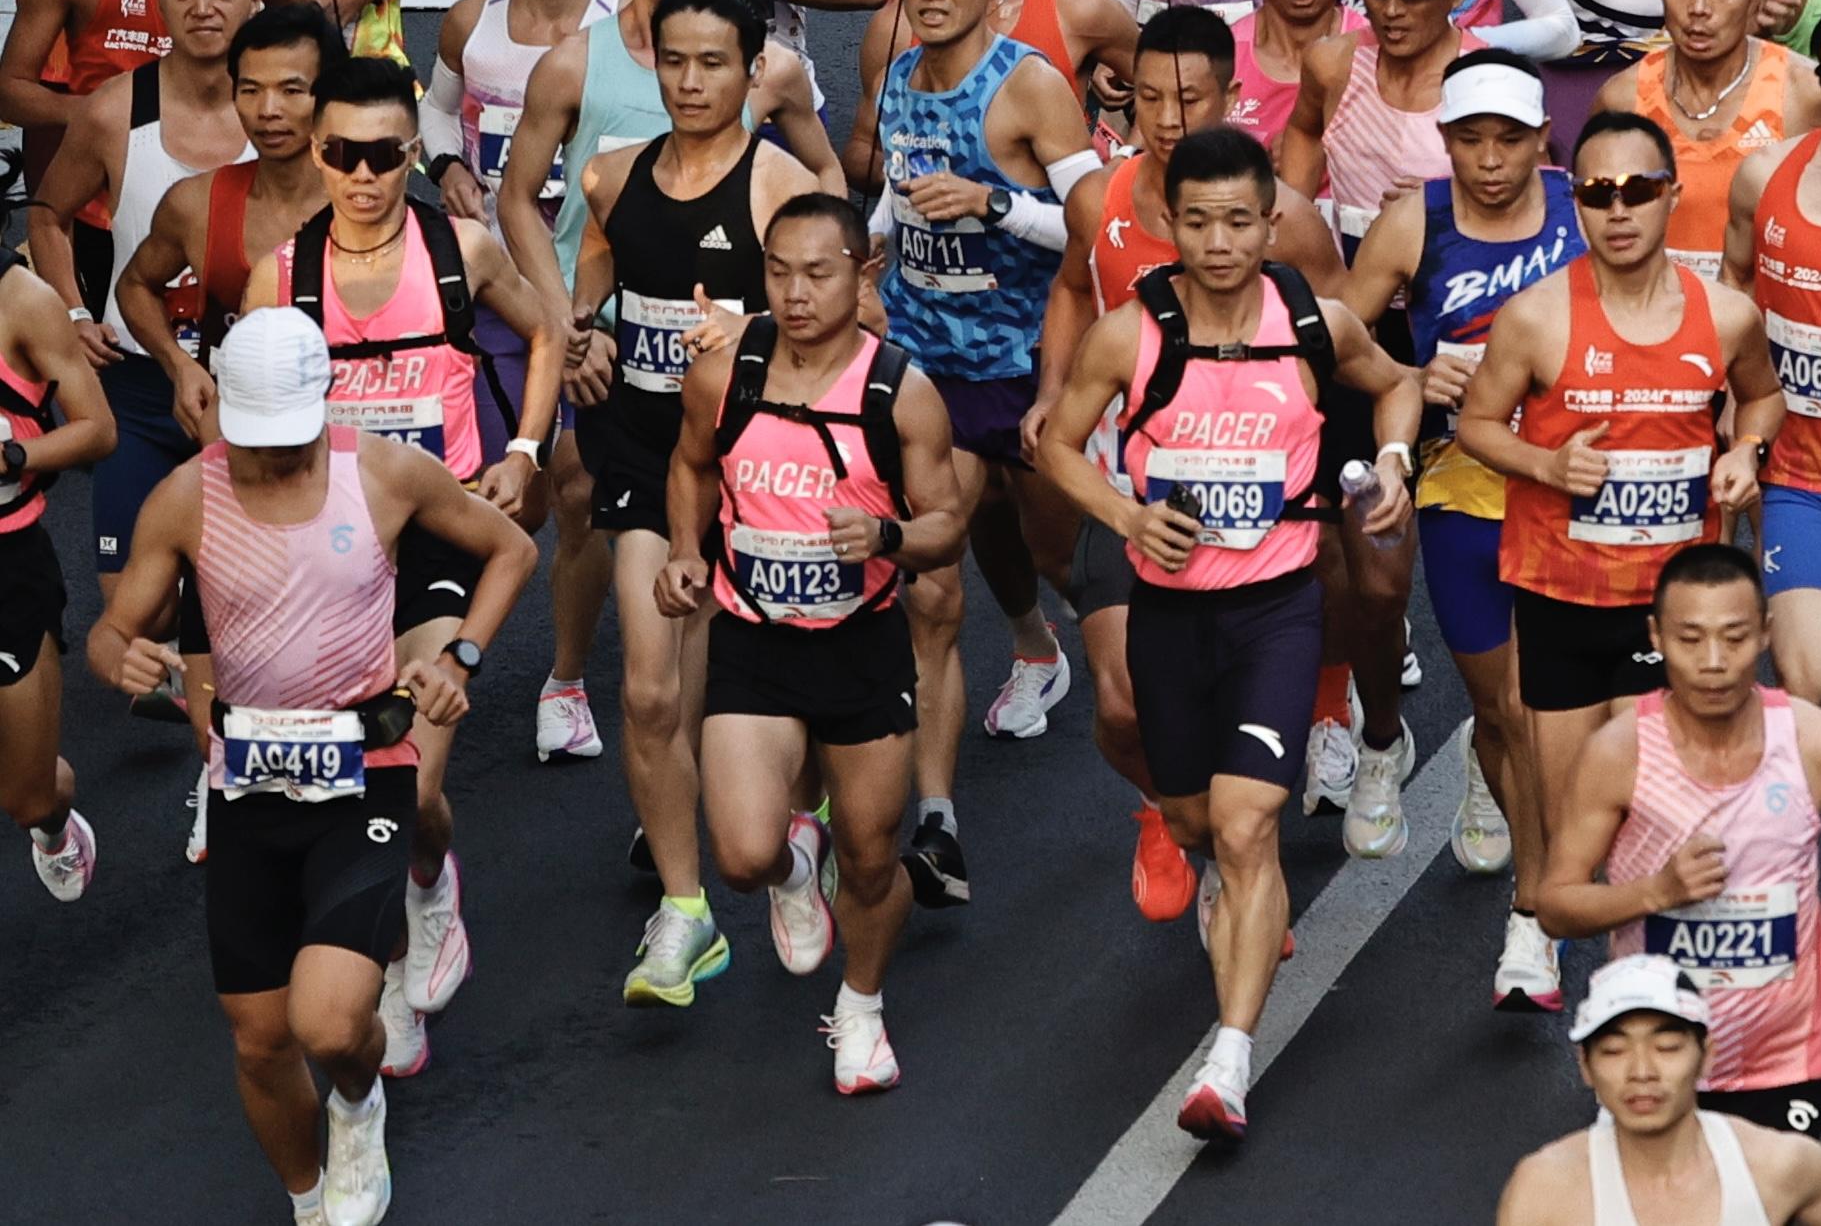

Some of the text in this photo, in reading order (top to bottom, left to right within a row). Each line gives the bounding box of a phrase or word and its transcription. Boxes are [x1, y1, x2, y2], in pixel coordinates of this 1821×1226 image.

[699, 239, 732, 251] adidas
[901, 227, 965, 267] A0711
[332, 356, 426, 396] PACER
[1169, 411, 1278, 448] PACER
[735, 458, 838, 500] PACER
[1594, 481, 1690, 517] A0295
[750, 559, 841, 595] A0123
[244, 741, 342, 779] A0419
[1668, 920, 1773, 958] A0221
